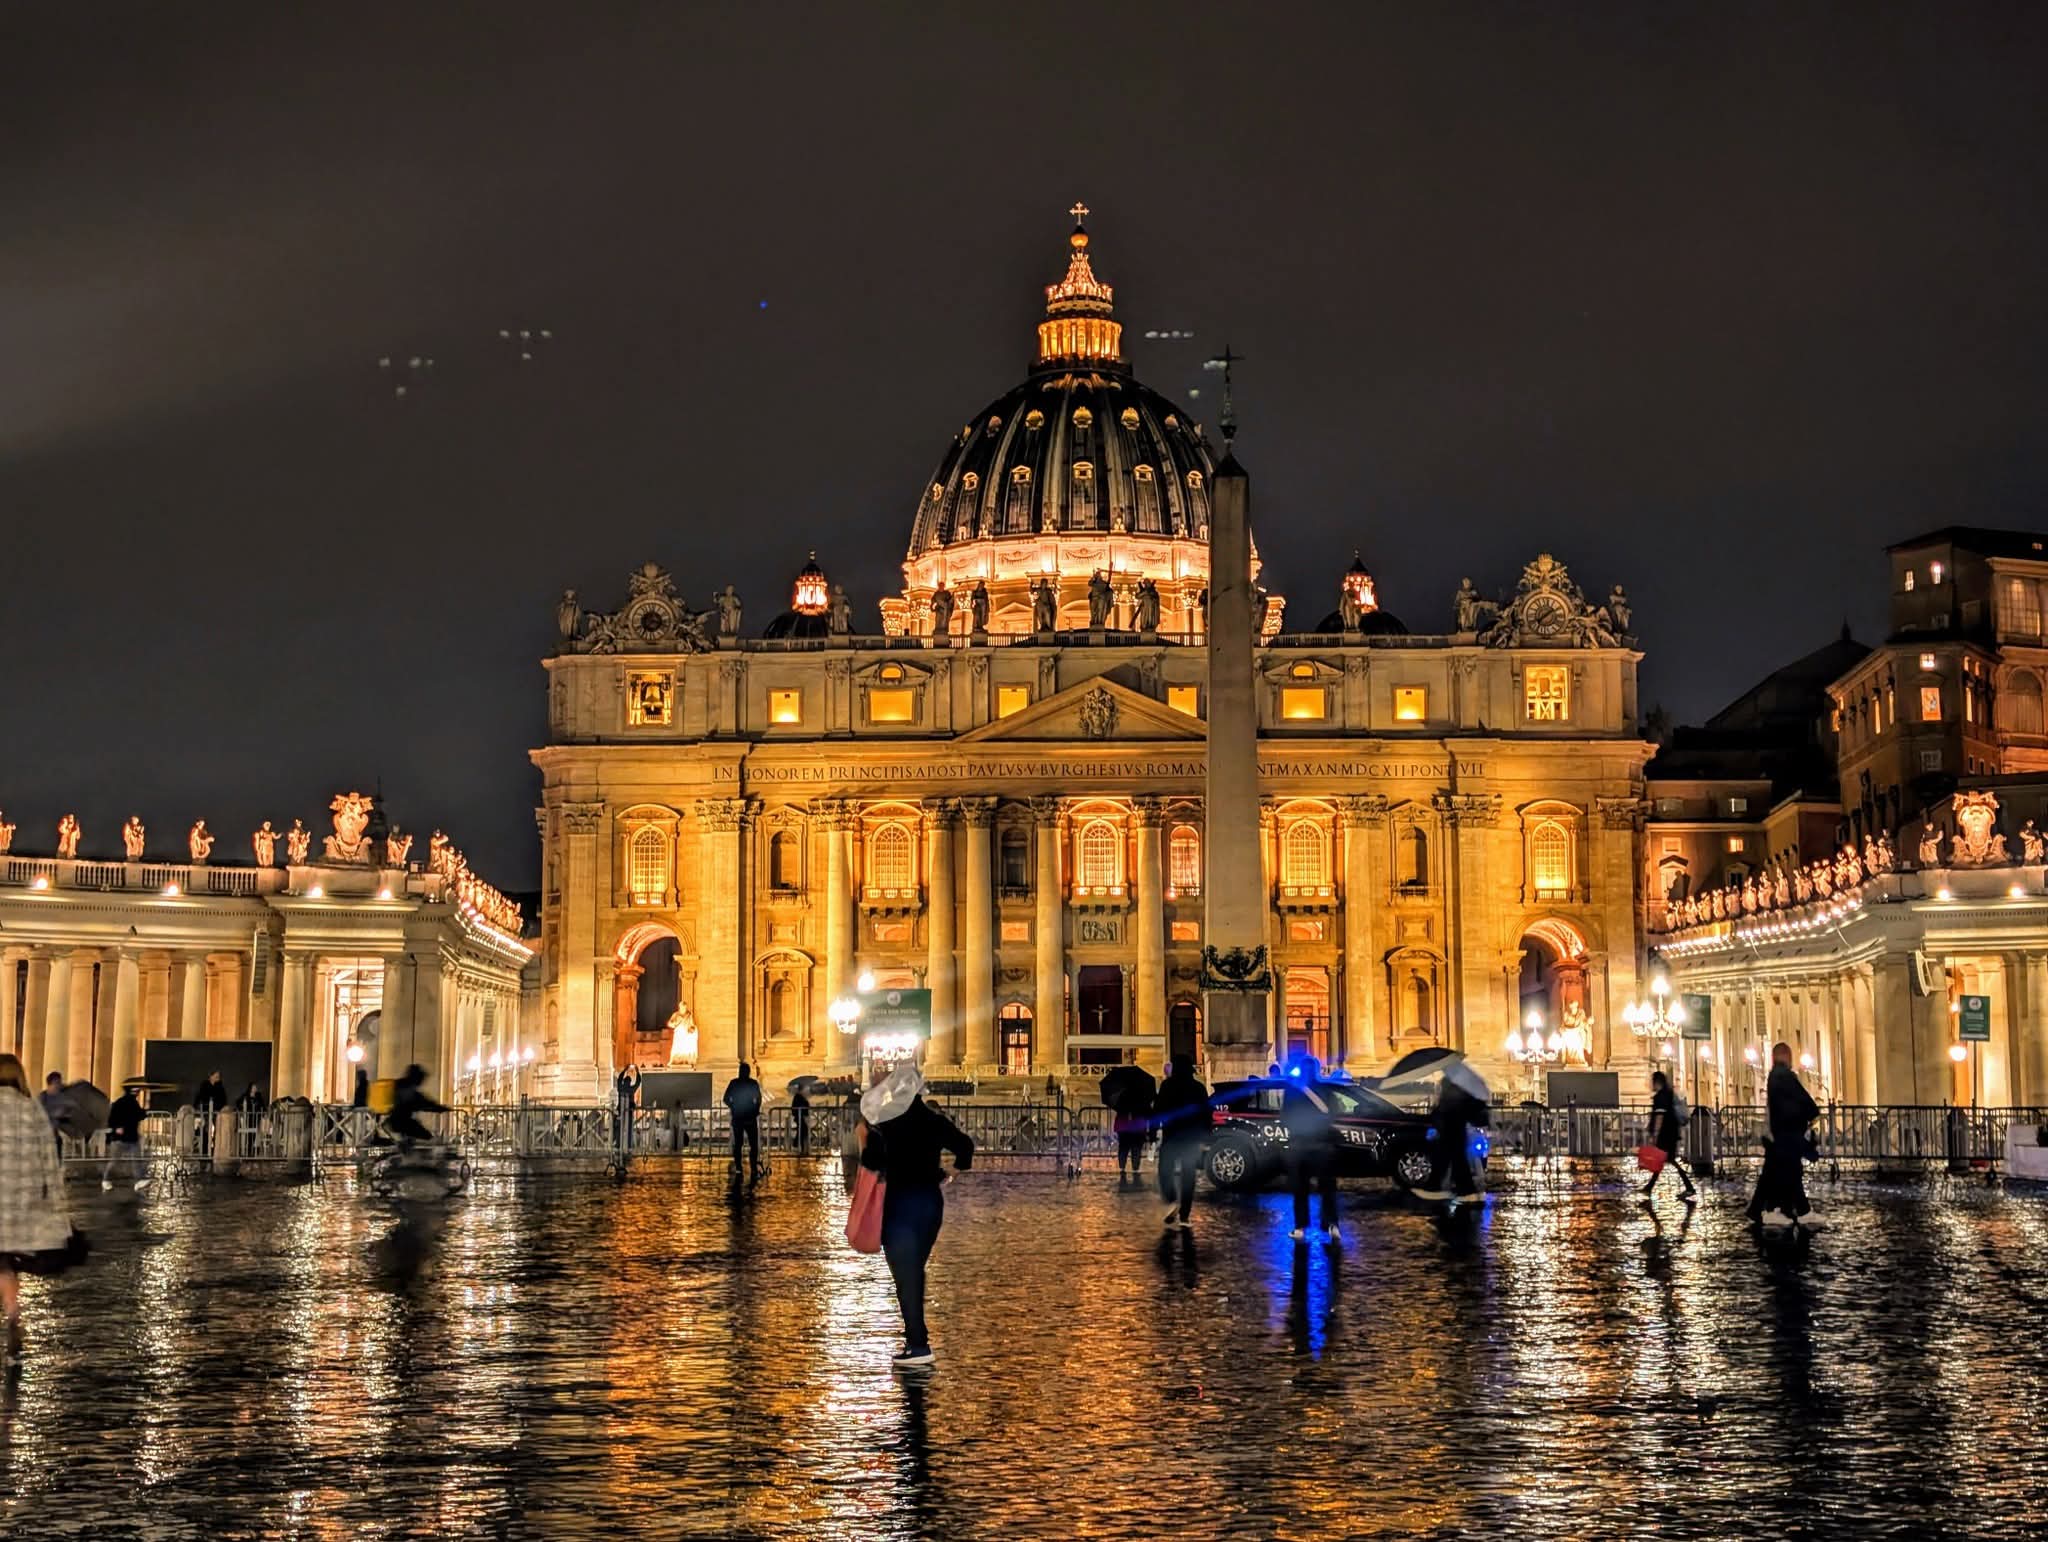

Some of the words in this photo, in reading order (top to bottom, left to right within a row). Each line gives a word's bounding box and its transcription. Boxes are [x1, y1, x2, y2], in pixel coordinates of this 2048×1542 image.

[714, 767, 733, 779] IN
[742, 767, 825, 780] HONOREM
[829, 766, 913, 778] PRINCIPIS
[915, 765, 967, 778] APOST
[968, 764, 1023, 777] PAVLVS
[1040, 763, 1142, 777] BVRGHESIVS
[1146, 763, 1207, 776] ROMAN
[1257, 763, 1275, 776] NT
[1277, 763, 1312, 776] MAX
[1314, 763, 1338, 776] AN
[1410, 764, 1453, 777] PONT
[1460, 763, 1483, 775] VII
